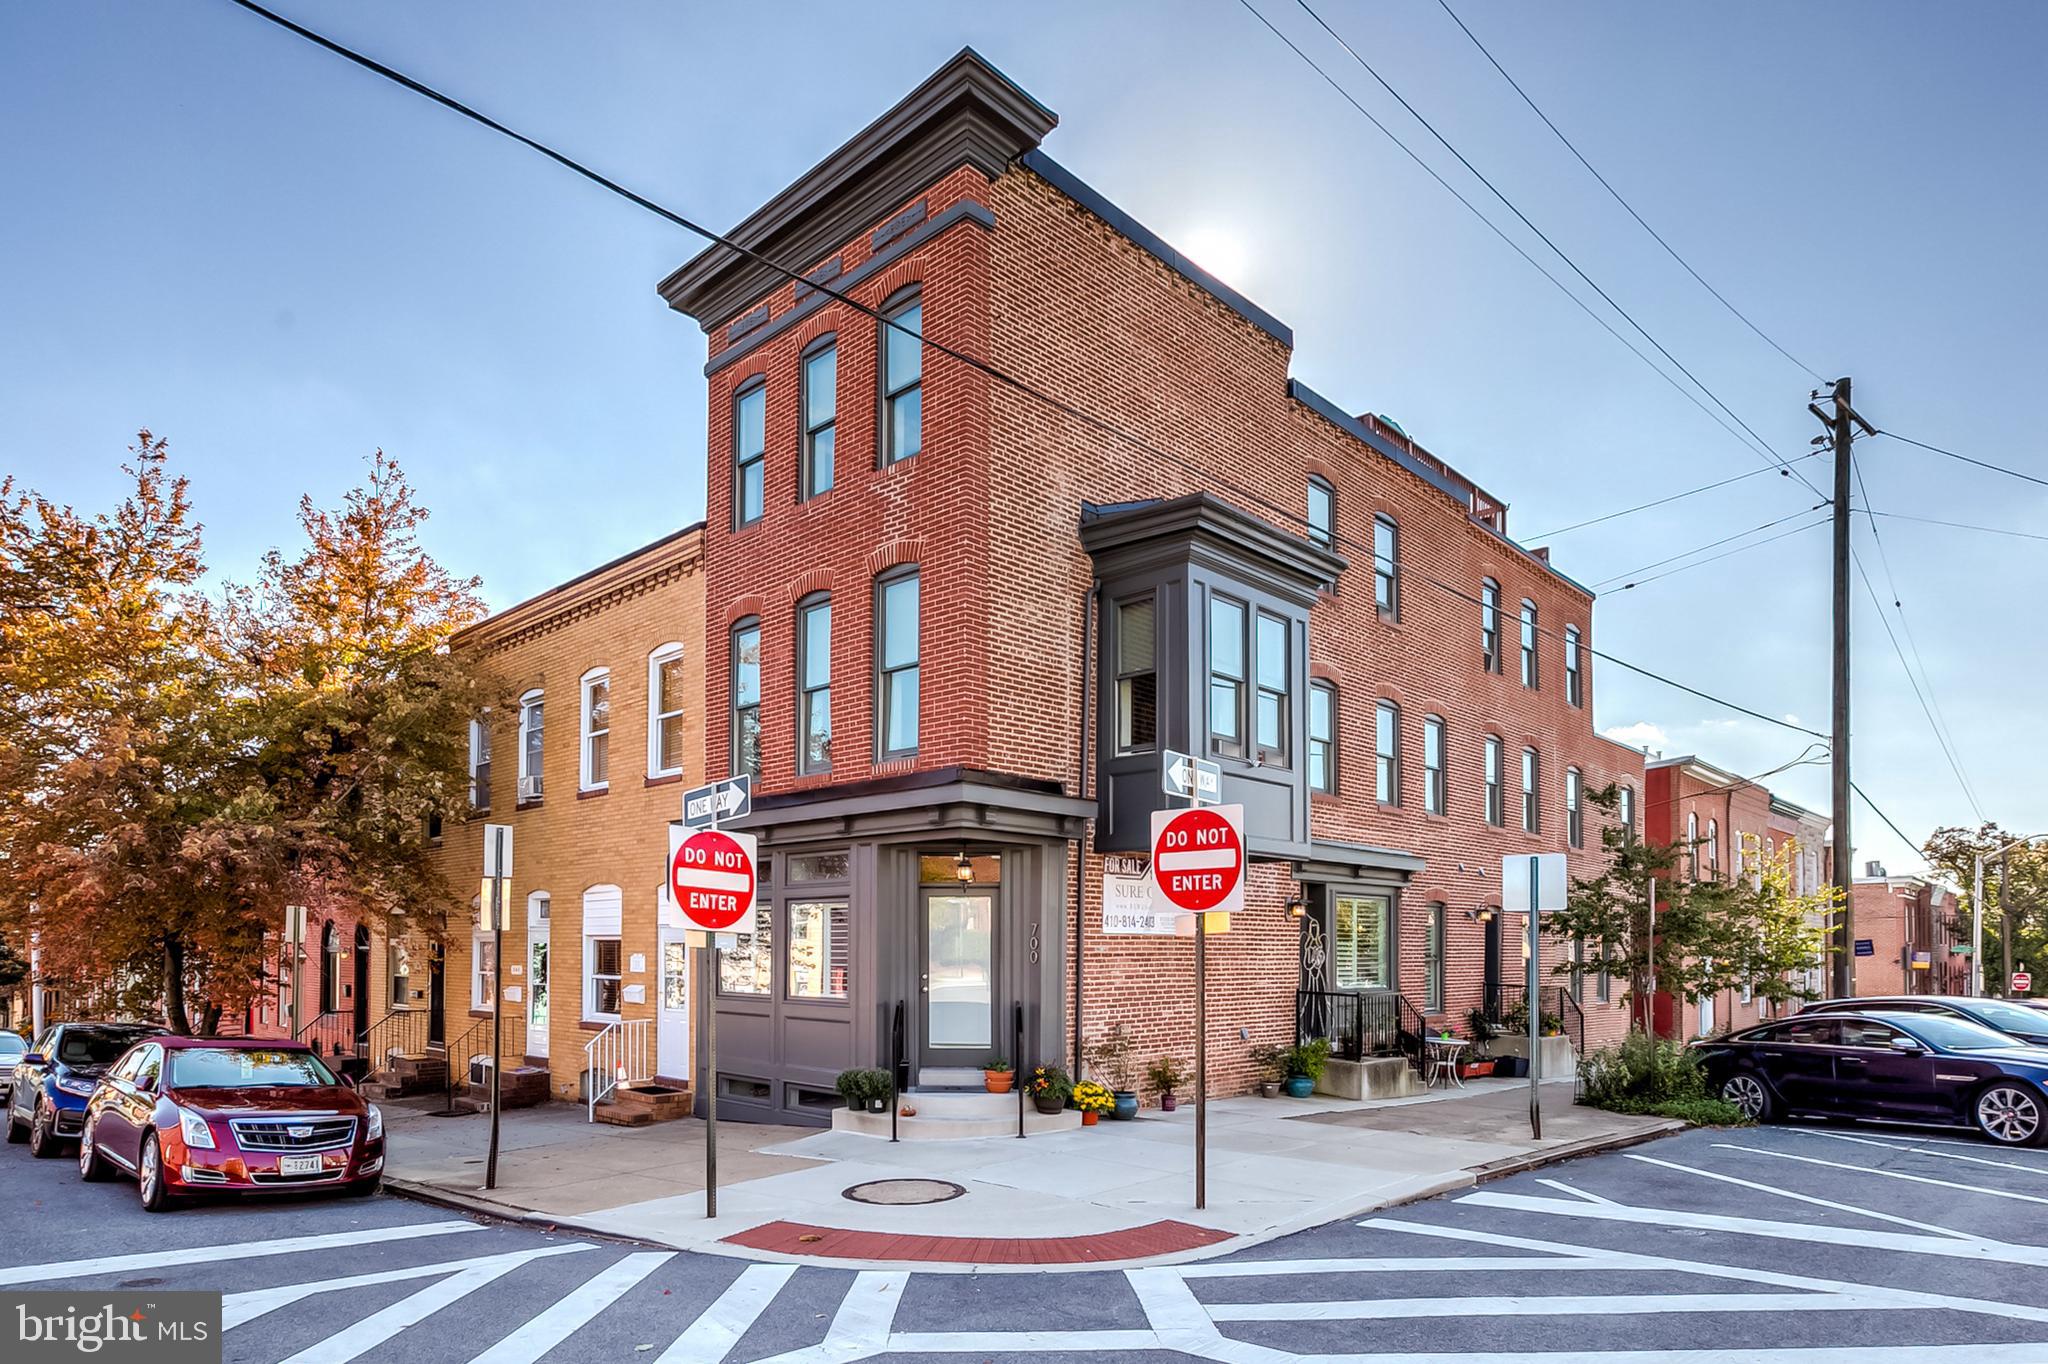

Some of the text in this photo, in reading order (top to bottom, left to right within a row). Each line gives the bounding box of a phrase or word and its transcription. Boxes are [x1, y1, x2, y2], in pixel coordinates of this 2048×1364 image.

[690, 799, 707, 816] ONE
[1166, 827, 1228, 848] DO NOT
[685, 847, 743, 869] DO NOT
[1104, 857, 1142, 875] FOR SALE
[1115, 884, 1144, 899] SURE
[1172, 874, 1223, 892] ENTER
[690, 892, 737, 911] ENTER
[1030, 923, 1039, 963] 700
